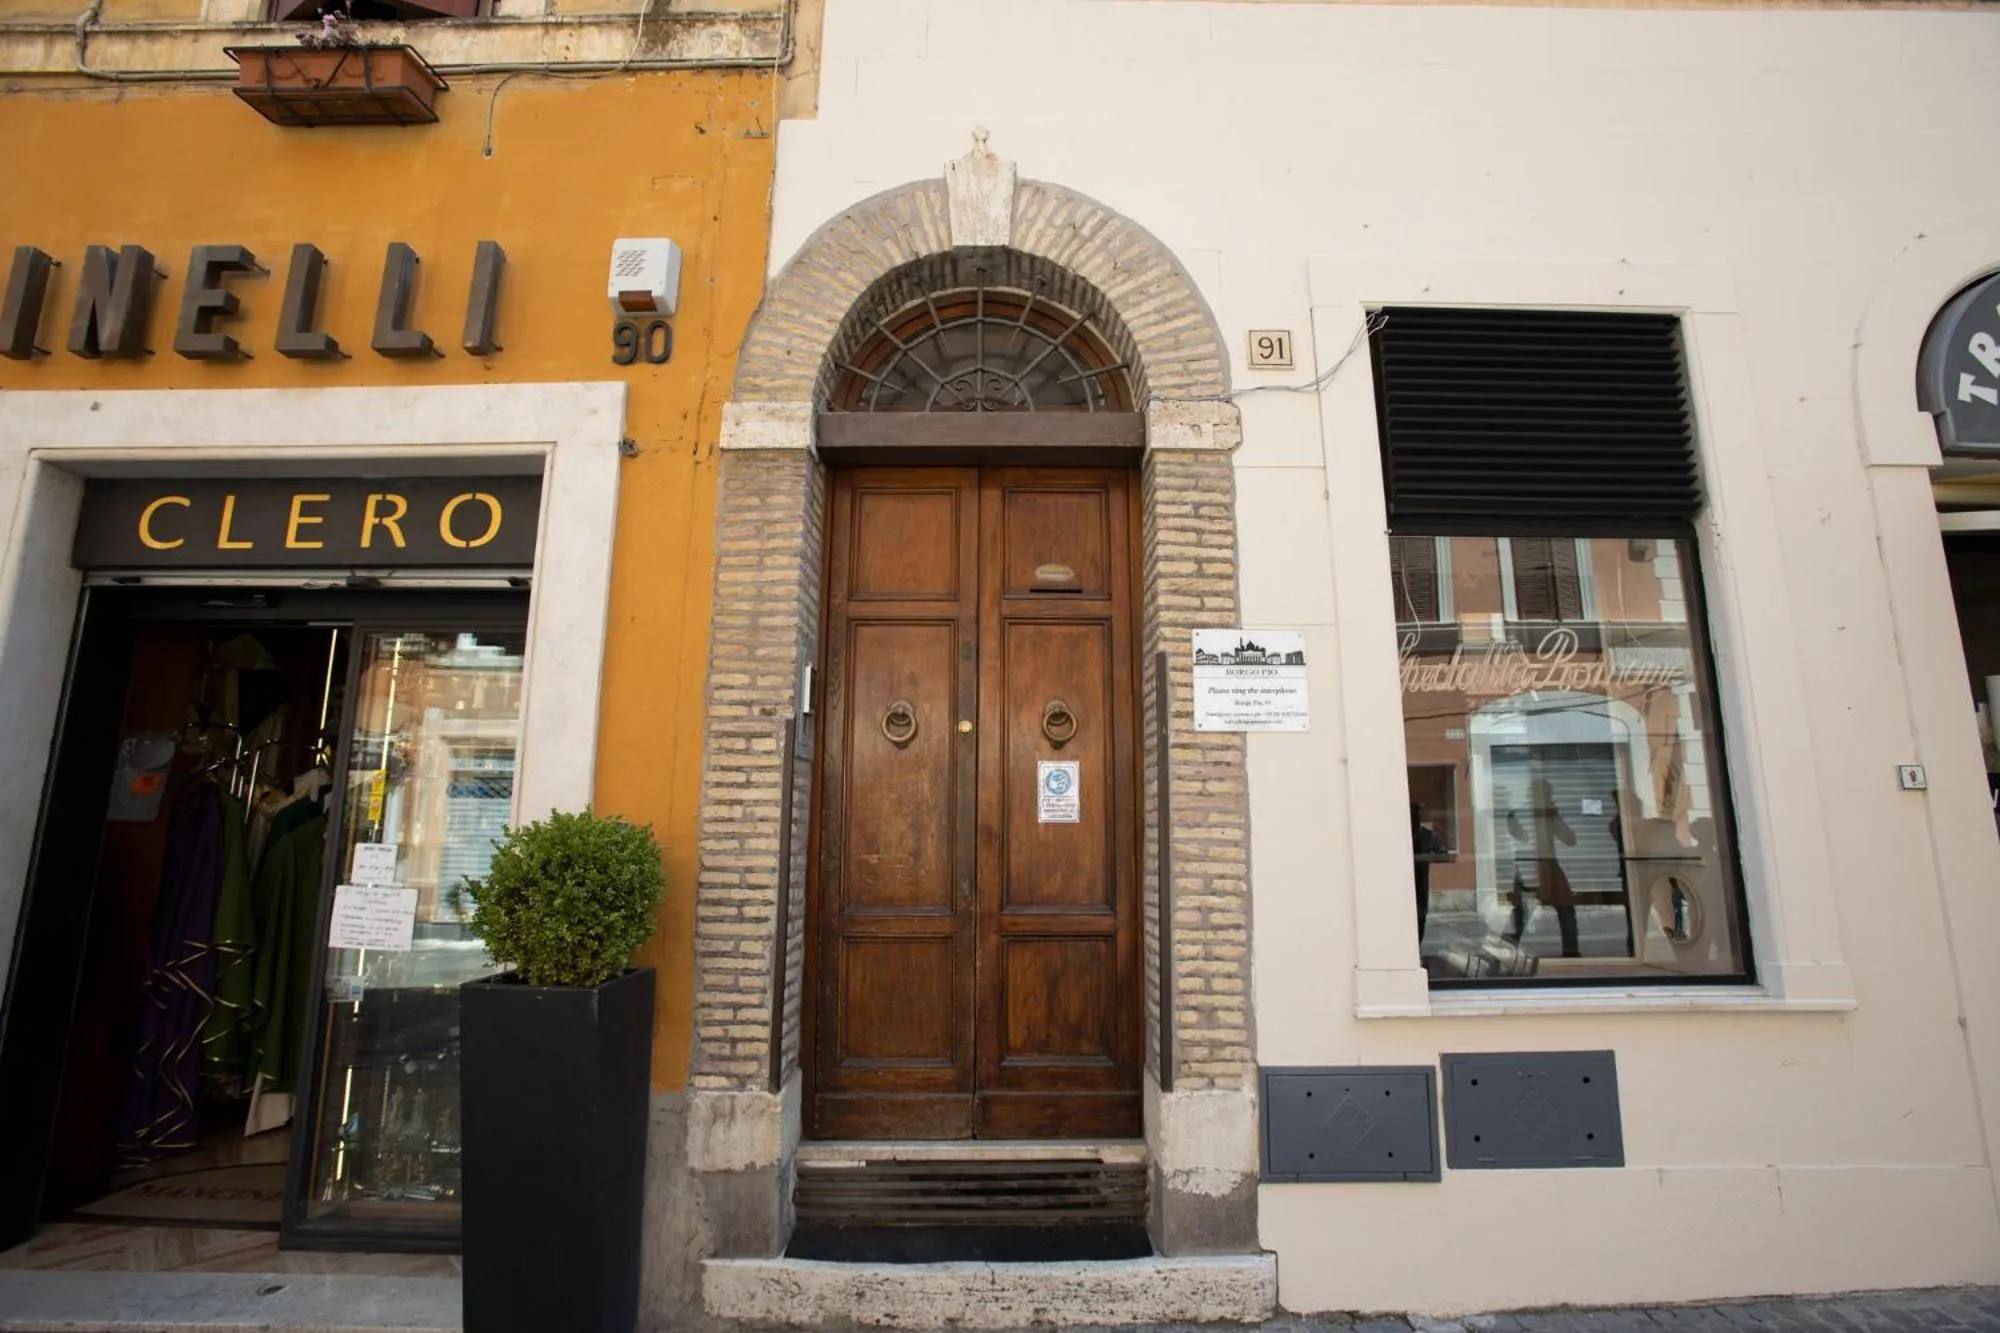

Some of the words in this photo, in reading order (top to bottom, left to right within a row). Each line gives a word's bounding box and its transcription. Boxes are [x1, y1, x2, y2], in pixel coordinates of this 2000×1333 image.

[0, 240, 505, 361] INELLI
[612, 320, 672, 365] 90
[1258, 336, 1284, 360] 91
[1957, 303, 2000, 406] TR
[137, 492, 503, 549] CLERO
[1208, 686, 1230, 694] Please
[1231, 687, 1246, 696] ring
[1247, 686, 1259, 694] the
[1260, 686, 1297, 696] interphone
[1225, 668, 1259, 676] BORGO
[1262, 668, 1279, 676] PIO
